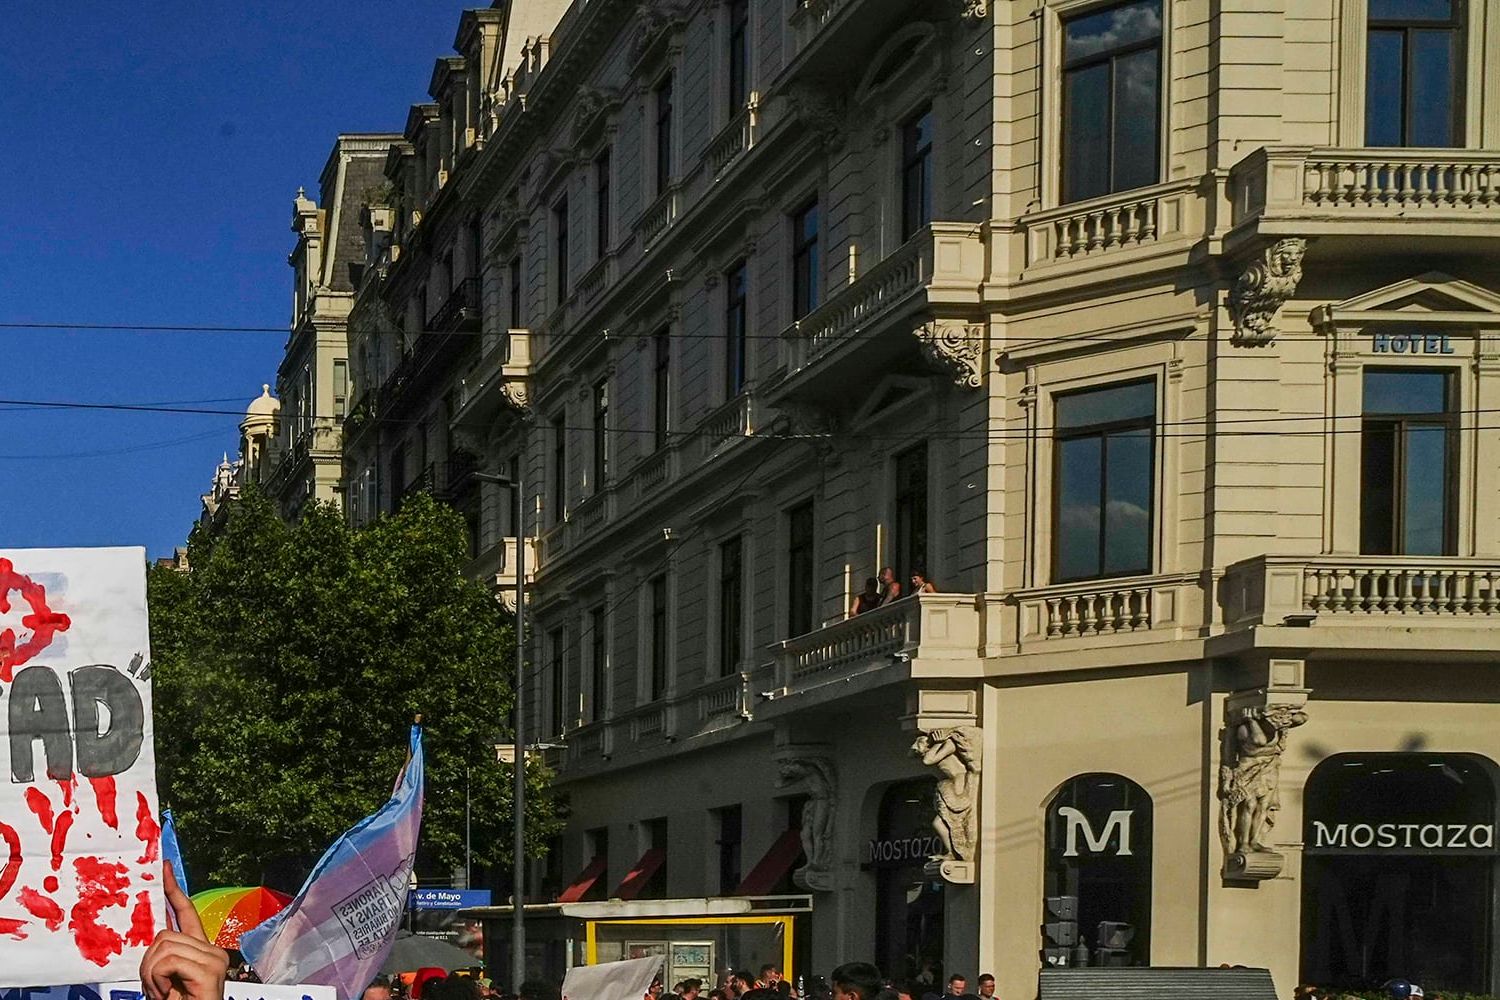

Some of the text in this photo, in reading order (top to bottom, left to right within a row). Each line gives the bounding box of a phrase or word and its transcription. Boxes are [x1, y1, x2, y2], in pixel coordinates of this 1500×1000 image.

[1373, 334, 1454, 354] HOTEL
[1058, 806, 1134, 857] M
[426, 892, 437, 900] de
[438, 892, 461, 902] Mayo
